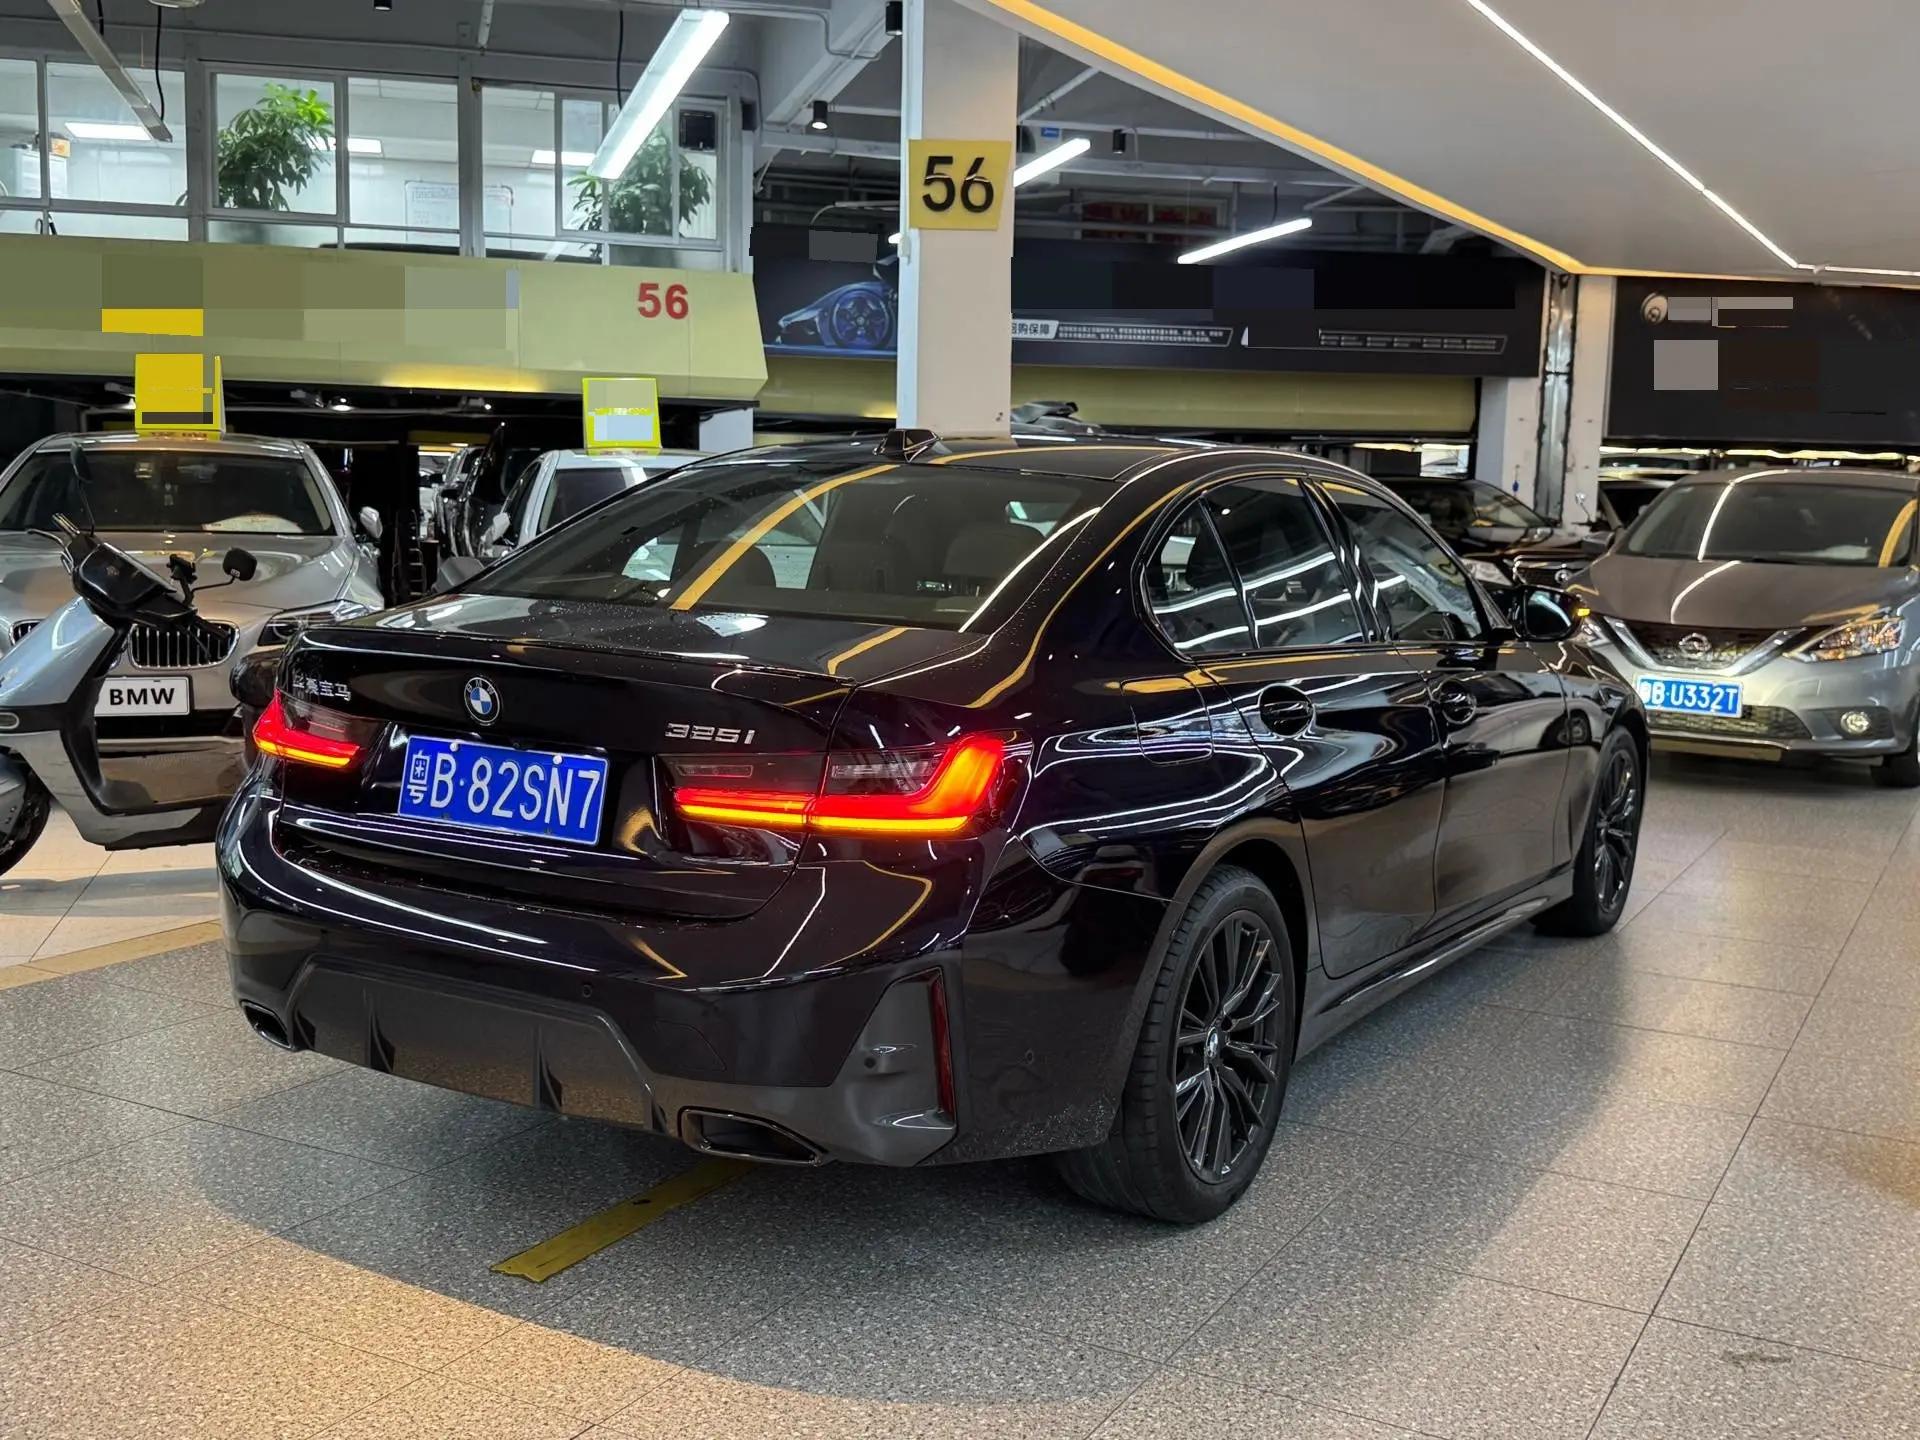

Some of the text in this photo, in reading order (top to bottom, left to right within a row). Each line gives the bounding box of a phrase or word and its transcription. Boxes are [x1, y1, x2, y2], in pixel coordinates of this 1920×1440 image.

[922, 155, 994, 213] 56
[638, 282, 689, 320] 56
[109, 688, 175, 706] BMW
